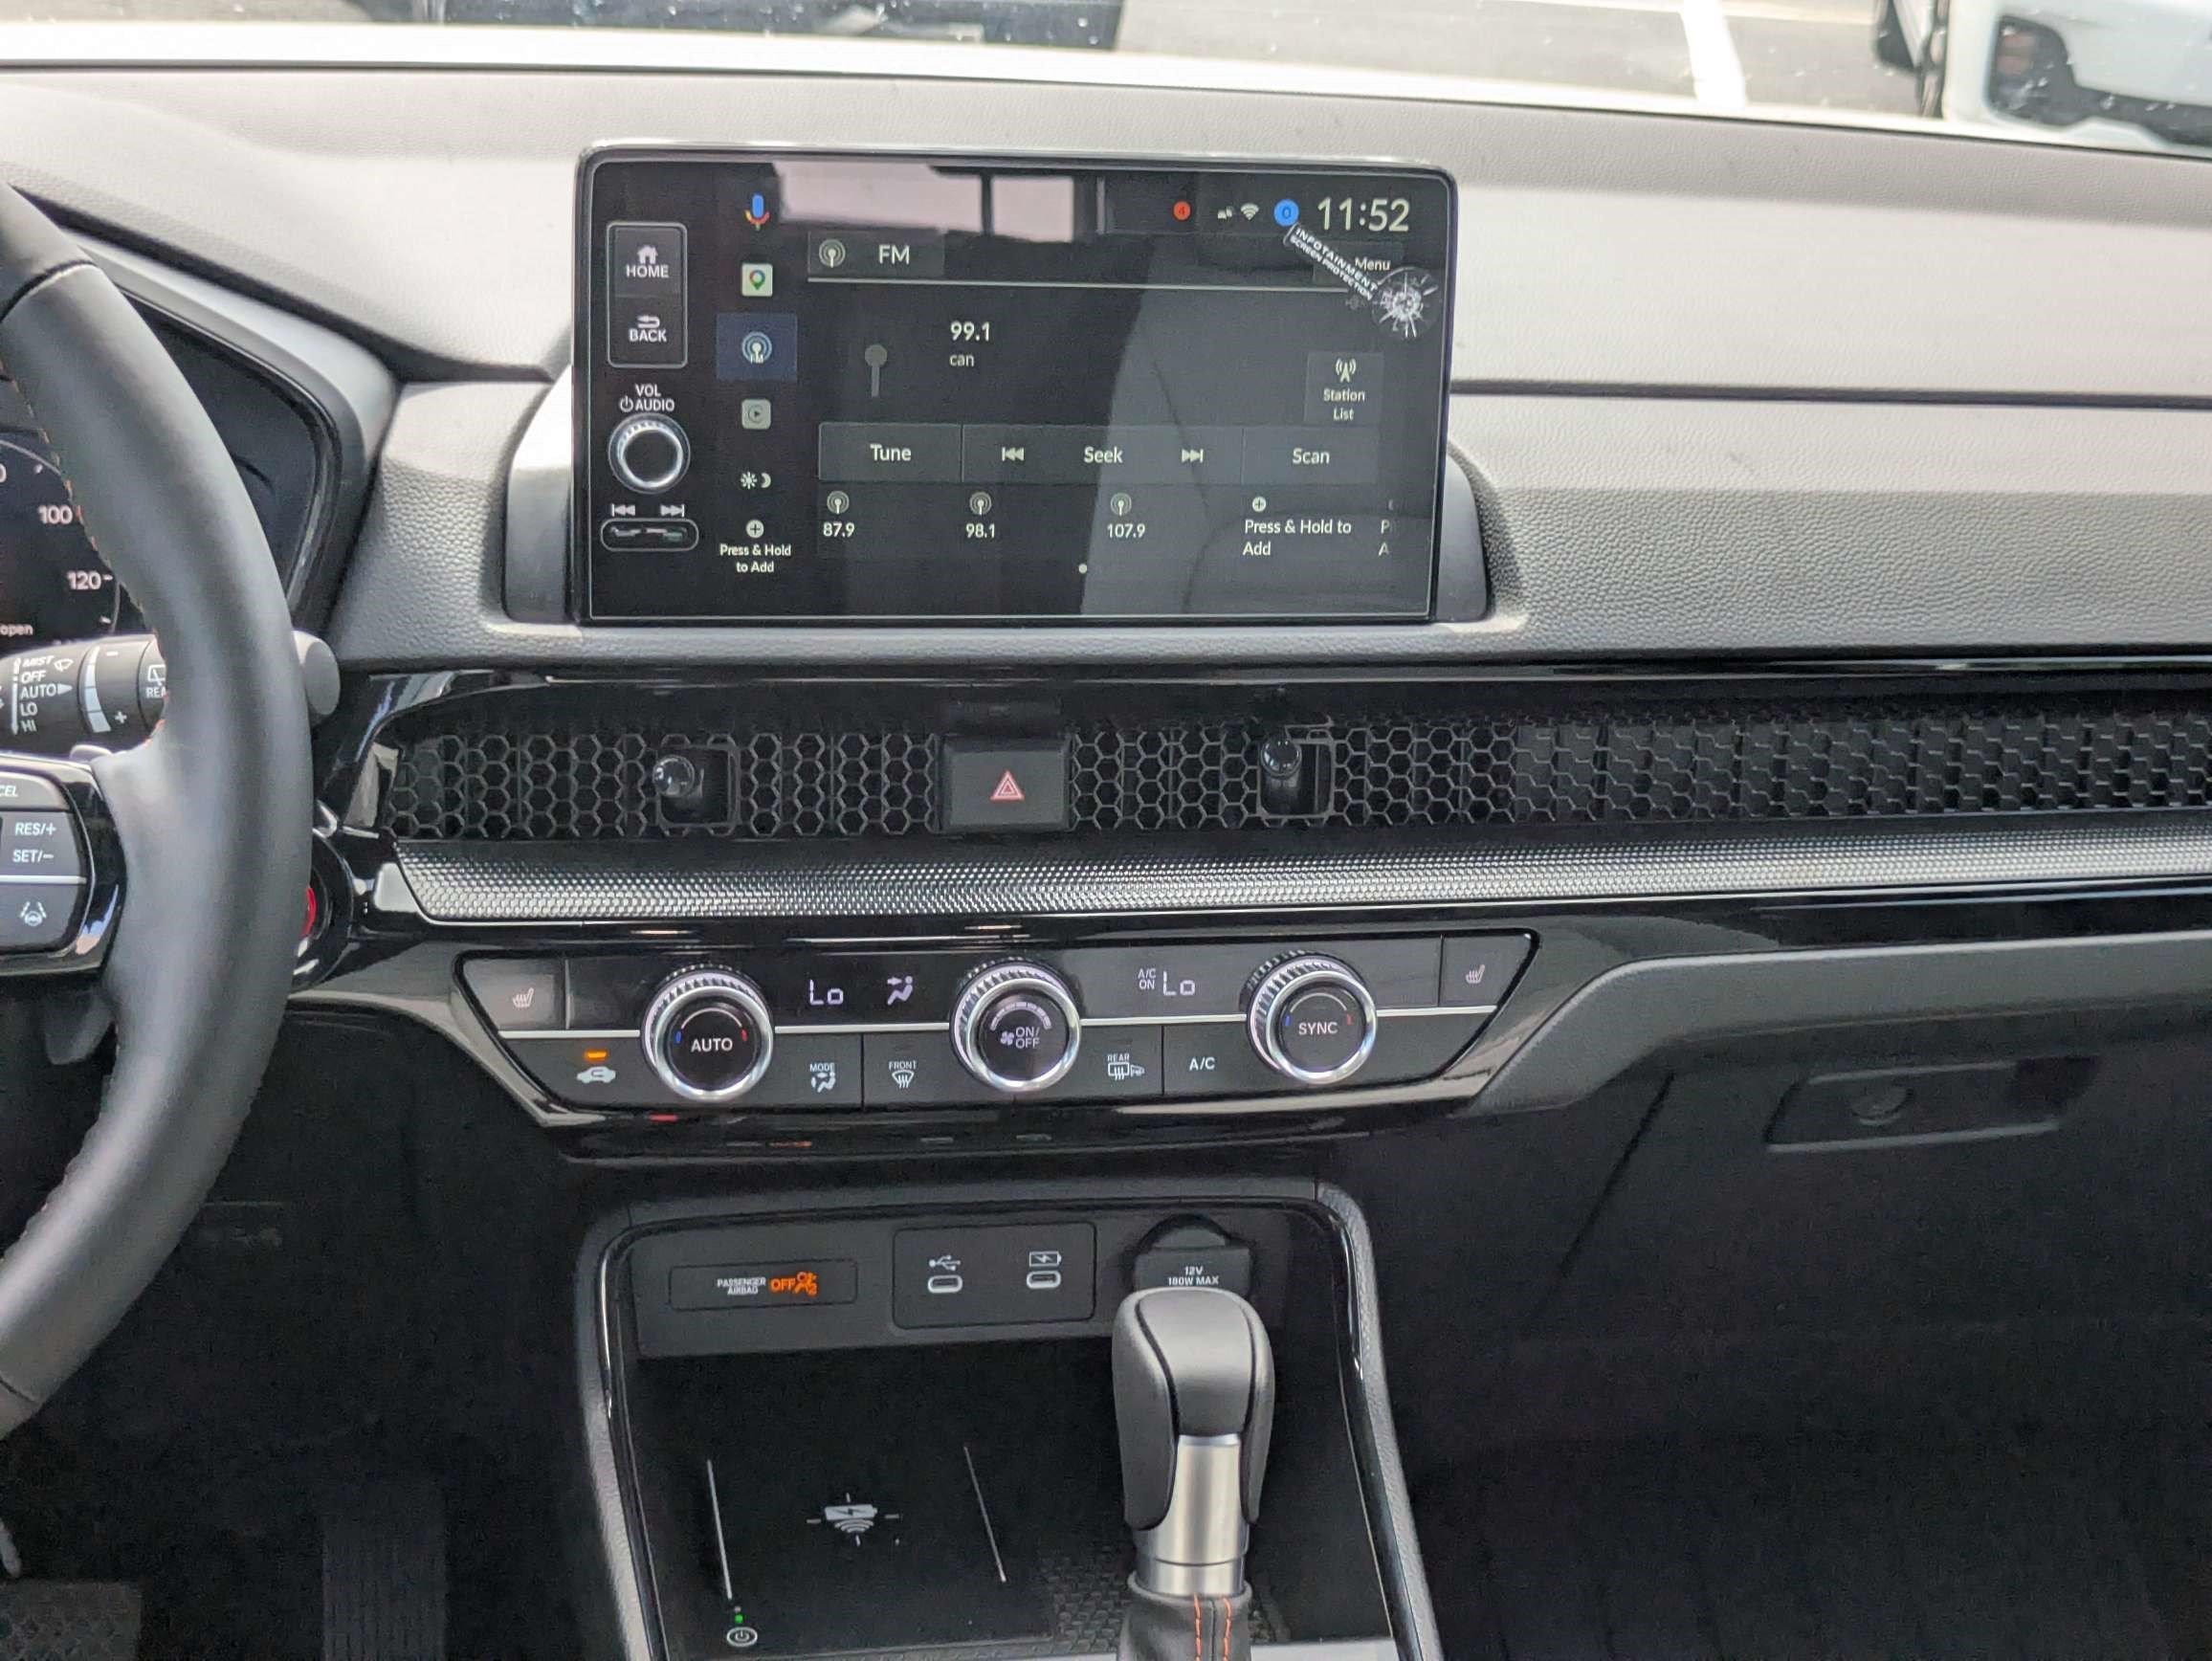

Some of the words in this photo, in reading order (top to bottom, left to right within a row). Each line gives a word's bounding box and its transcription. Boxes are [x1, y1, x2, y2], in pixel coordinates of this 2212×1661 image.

[1317, 197, 1410, 232] 11:52
[878, 245, 910, 264] FM
[1294, 226, 1379, 293] INFOTAINMENT
[626, 265, 670, 278] HOME
[1354, 256, 1392, 272] Menu
[629, 328, 668, 343] BACK
[950, 321, 991, 342] 99.1
[949, 353, 975, 367] can
[634, 383, 662, 398] VOL
[1323, 388, 1366, 403] Station
[634, 397, 675, 412] AUDIO
[1332, 408, 1355, 421] List
[870, 443, 912, 462] Tune
[1083, 445, 1123, 464] Seek
[1292, 447, 1331, 465] Scan
[38, 504, 74, 524] 100
[823, 521, 855, 538] 87.9
[965, 523, 996, 539] 98.1
[1106, 523, 1146, 539] 107.9
[1245, 519, 1281, 534] Press
[1284, 519, 1295, 534] &
[1300, 519, 1333, 534] Hold
[1337, 520, 1352, 534] to
[719, 543, 749, 557] Press
[752, 543, 762, 557] &
[764, 543, 792, 557] Hold
[1242, 541, 1272, 556] Add
[736, 561, 748, 573] to
[750, 561, 775, 573] Add
[66, 571, 101, 590] 120
[0, 624, 33, 638] open
[22, 654, 55, 668] MIST
[21, 670, 47, 684] OFF
[20, 683, 57, 699] AUTO
[20, 701, 38, 718] LO
[20, 720, 37, 733] HI
[1138, 966, 1157, 979] A/C
[1139, 978, 1156, 991] ON
[1162, 969, 1196, 996] Lo
[809, 979, 844, 1006] Lo
[1015, 1026, 1041, 1038] ON/
[1296, 1021, 1338, 1036] SYNC
[691, 1037, 734, 1053] AUTO
[1015, 1037, 1041, 1050] OFF
[1107, 1052, 1130, 1062] REAR
[1188, 1056, 1216, 1072] A/C
[809, 1062, 836, 1073] MODE
[888, 1060, 918, 1072] FRONT
[716, 1275, 766, 1288] PASSENGER
[769, 1277, 797, 1293] OFF
[1195, 1274, 1220, 1286] MAX
